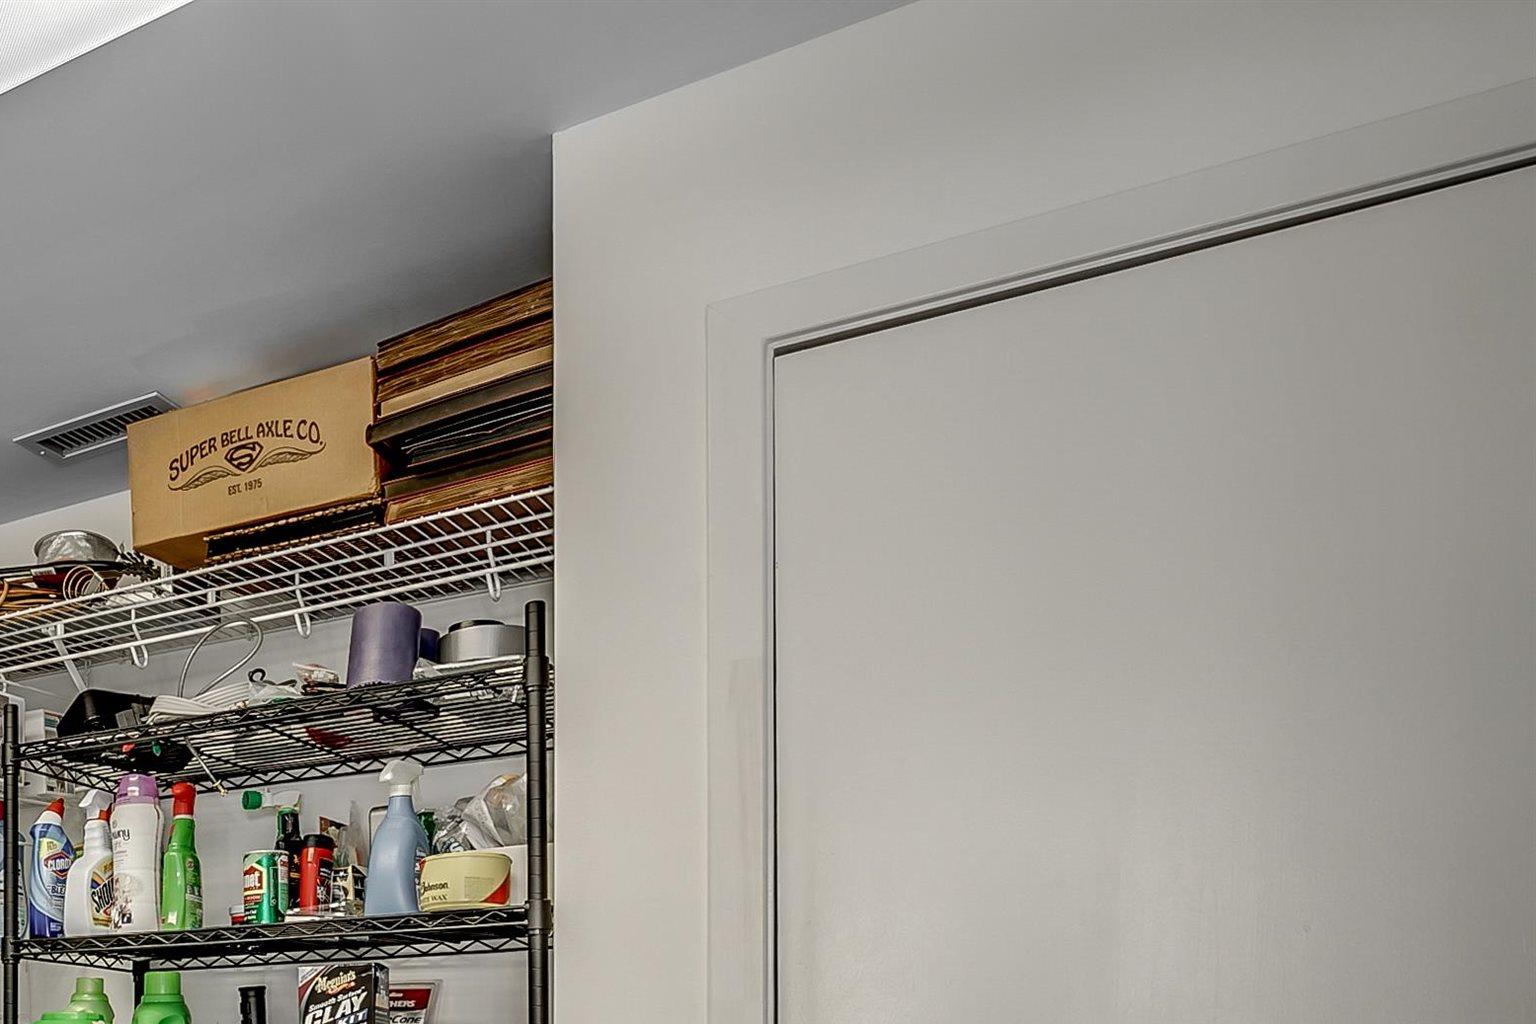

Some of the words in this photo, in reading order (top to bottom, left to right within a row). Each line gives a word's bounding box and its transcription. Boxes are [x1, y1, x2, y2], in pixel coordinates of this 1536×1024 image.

[169, 437, 217, 481] SUPER
[221, 426, 253, 448] BELL
[256, 420, 293, 438] AXLE
[296, 419, 324, 446] CO.
[244, 478, 263, 493] 1975
[421, 881, 449, 896] Johnson
